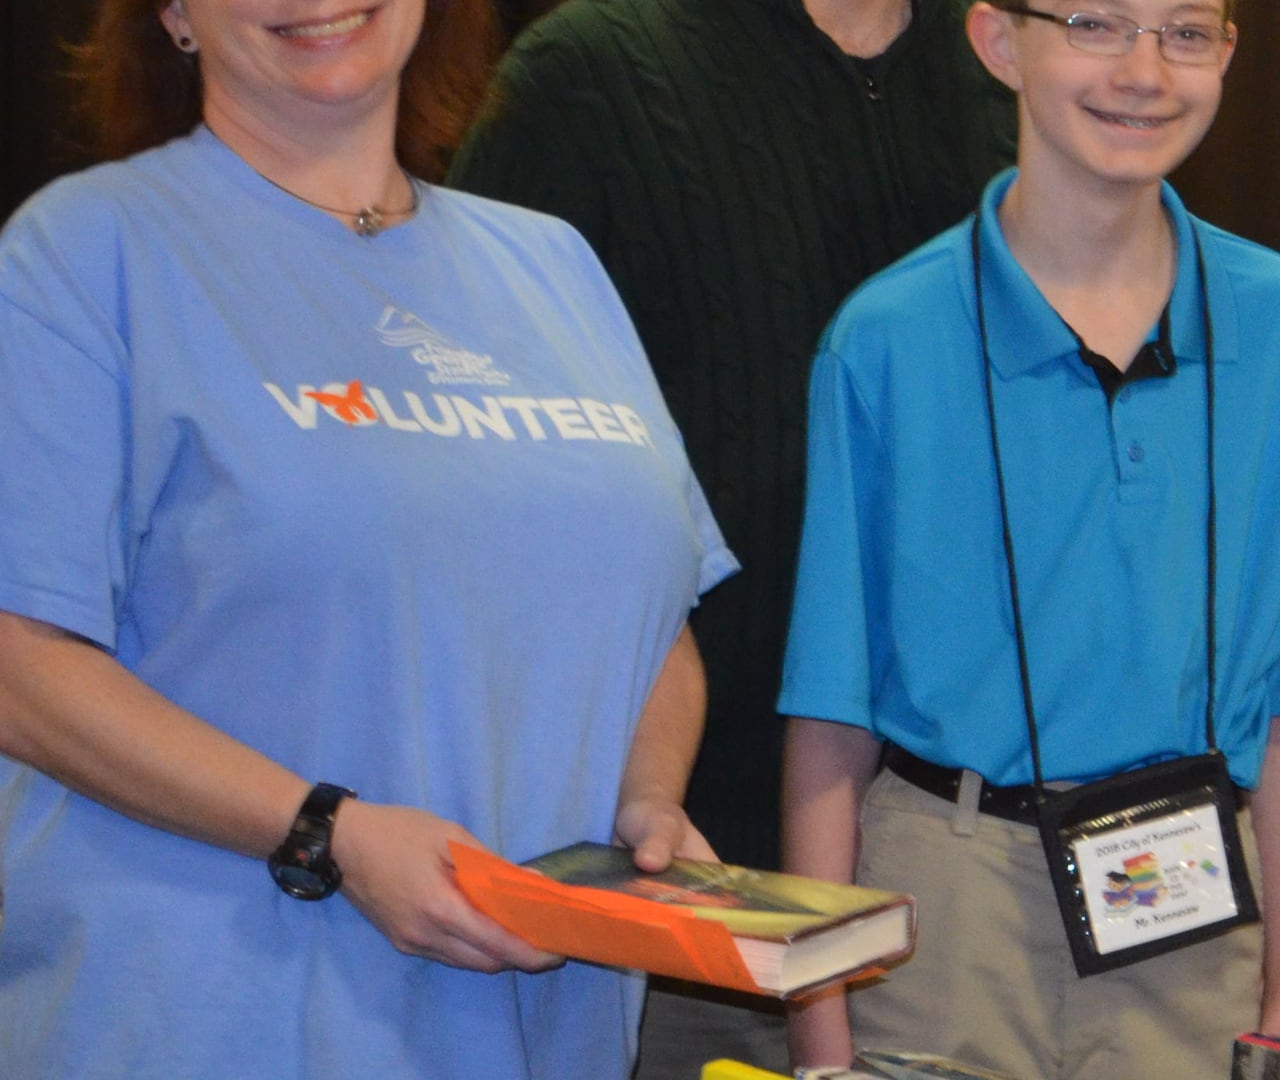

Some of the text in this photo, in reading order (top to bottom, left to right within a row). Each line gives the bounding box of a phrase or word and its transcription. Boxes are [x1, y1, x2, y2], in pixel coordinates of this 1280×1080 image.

[263, 380, 656, 448] VOLUNTEER
[1096, 843, 1120, 858] 2018
[1122, 838, 1141, 852] City
